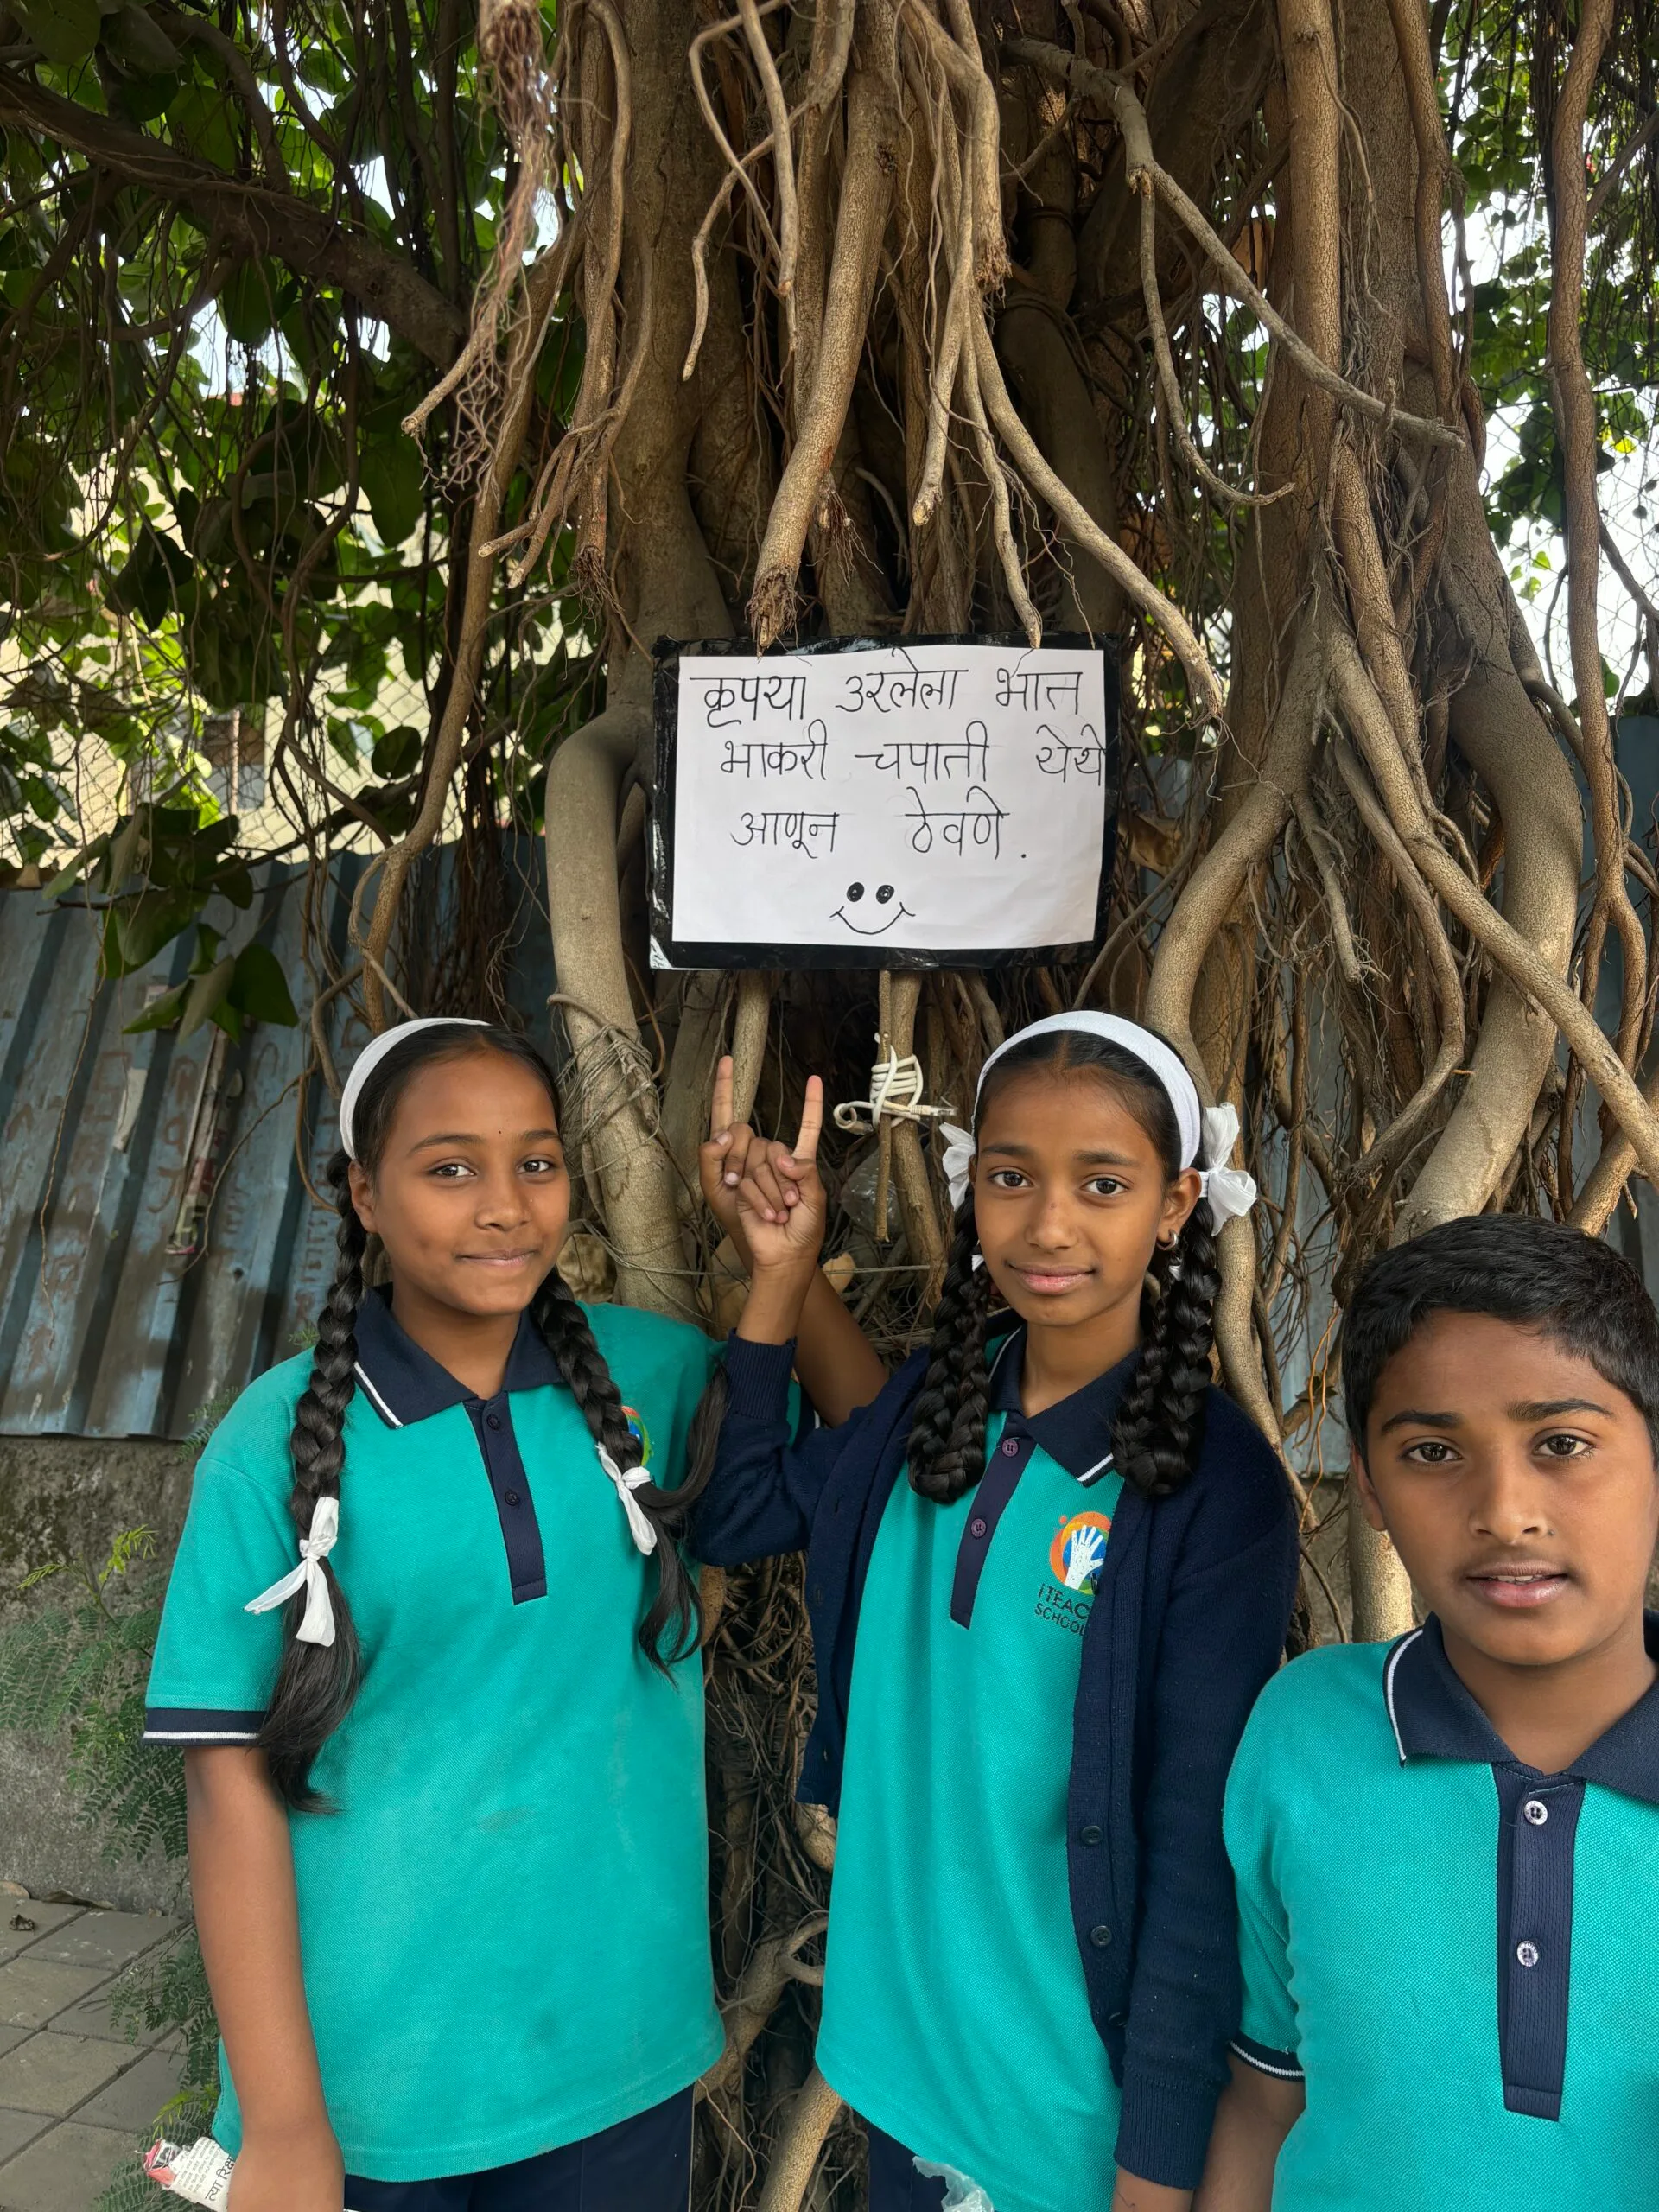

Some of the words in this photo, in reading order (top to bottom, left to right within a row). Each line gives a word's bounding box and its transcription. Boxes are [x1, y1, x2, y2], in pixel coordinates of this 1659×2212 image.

[689, 674, 806, 728] कृपया
[835, 647, 969, 713] उरलेला
[995, 667, 1083, 715] भात
[720, 719, 828, 780] भाकरी
[855, 721, 990, 784] चपाती
[1036, 723, 1106, 786] येथे
[731, 811, 840, 859] आणून
[1034, 1602, 1085, 1636] SCHOOL
[1038, 1582, 1090, 1620] iTEAC
